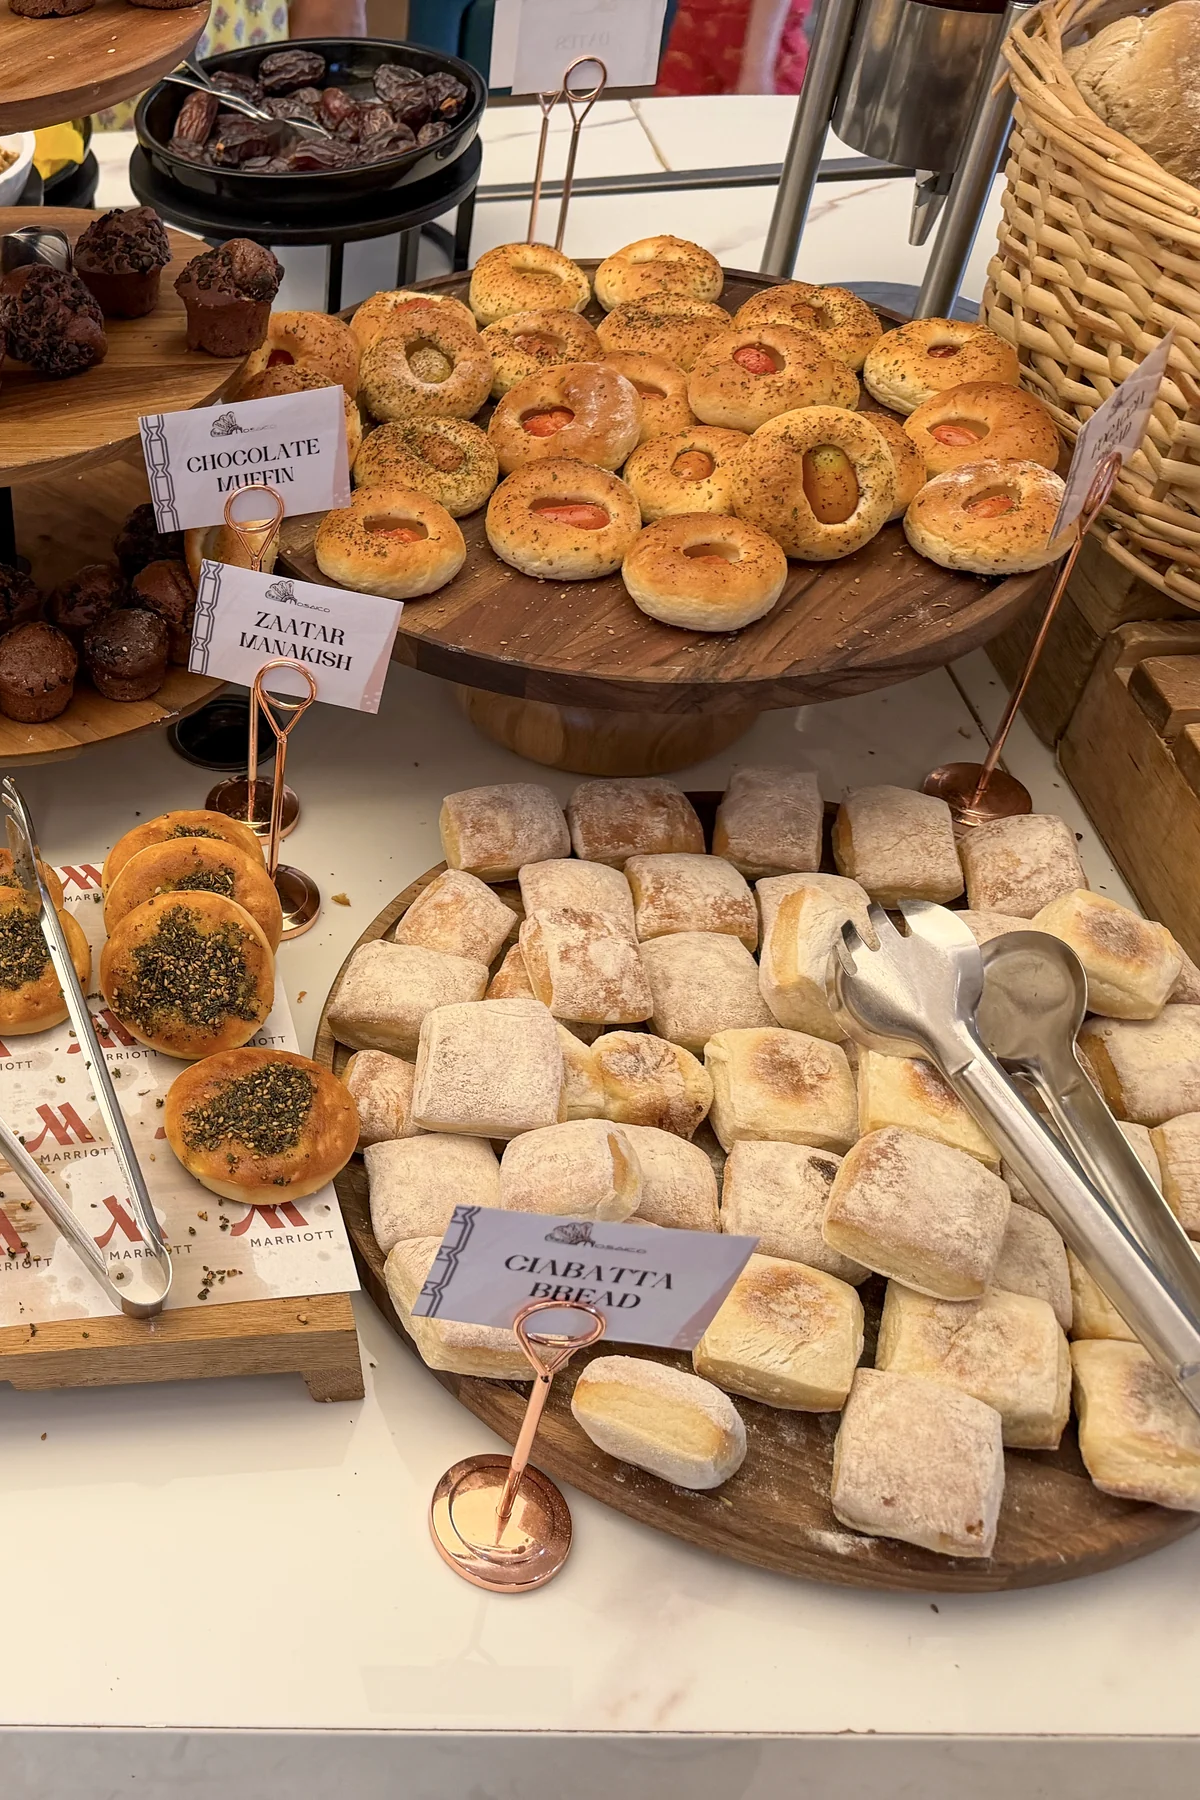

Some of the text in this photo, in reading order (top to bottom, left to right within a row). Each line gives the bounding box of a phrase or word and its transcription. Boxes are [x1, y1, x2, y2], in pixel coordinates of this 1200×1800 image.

[186, 438, 321, 473] CHOCOLATE
[216, 466, 295, 493] MUFFIN
[254, 610, 346, 647] ZAATAR
[239, 631, 353, 672] MANAKISH
[106, 1049, 159, 1061] RRIOTT
[250, 1229, 335, 1247] MARRIOTT
[109, 1244, 193, 1261] MARRTT
[504, 1254, 673, 1290] CIABATTA
[528, 1281, 643, 1309] BREAD
